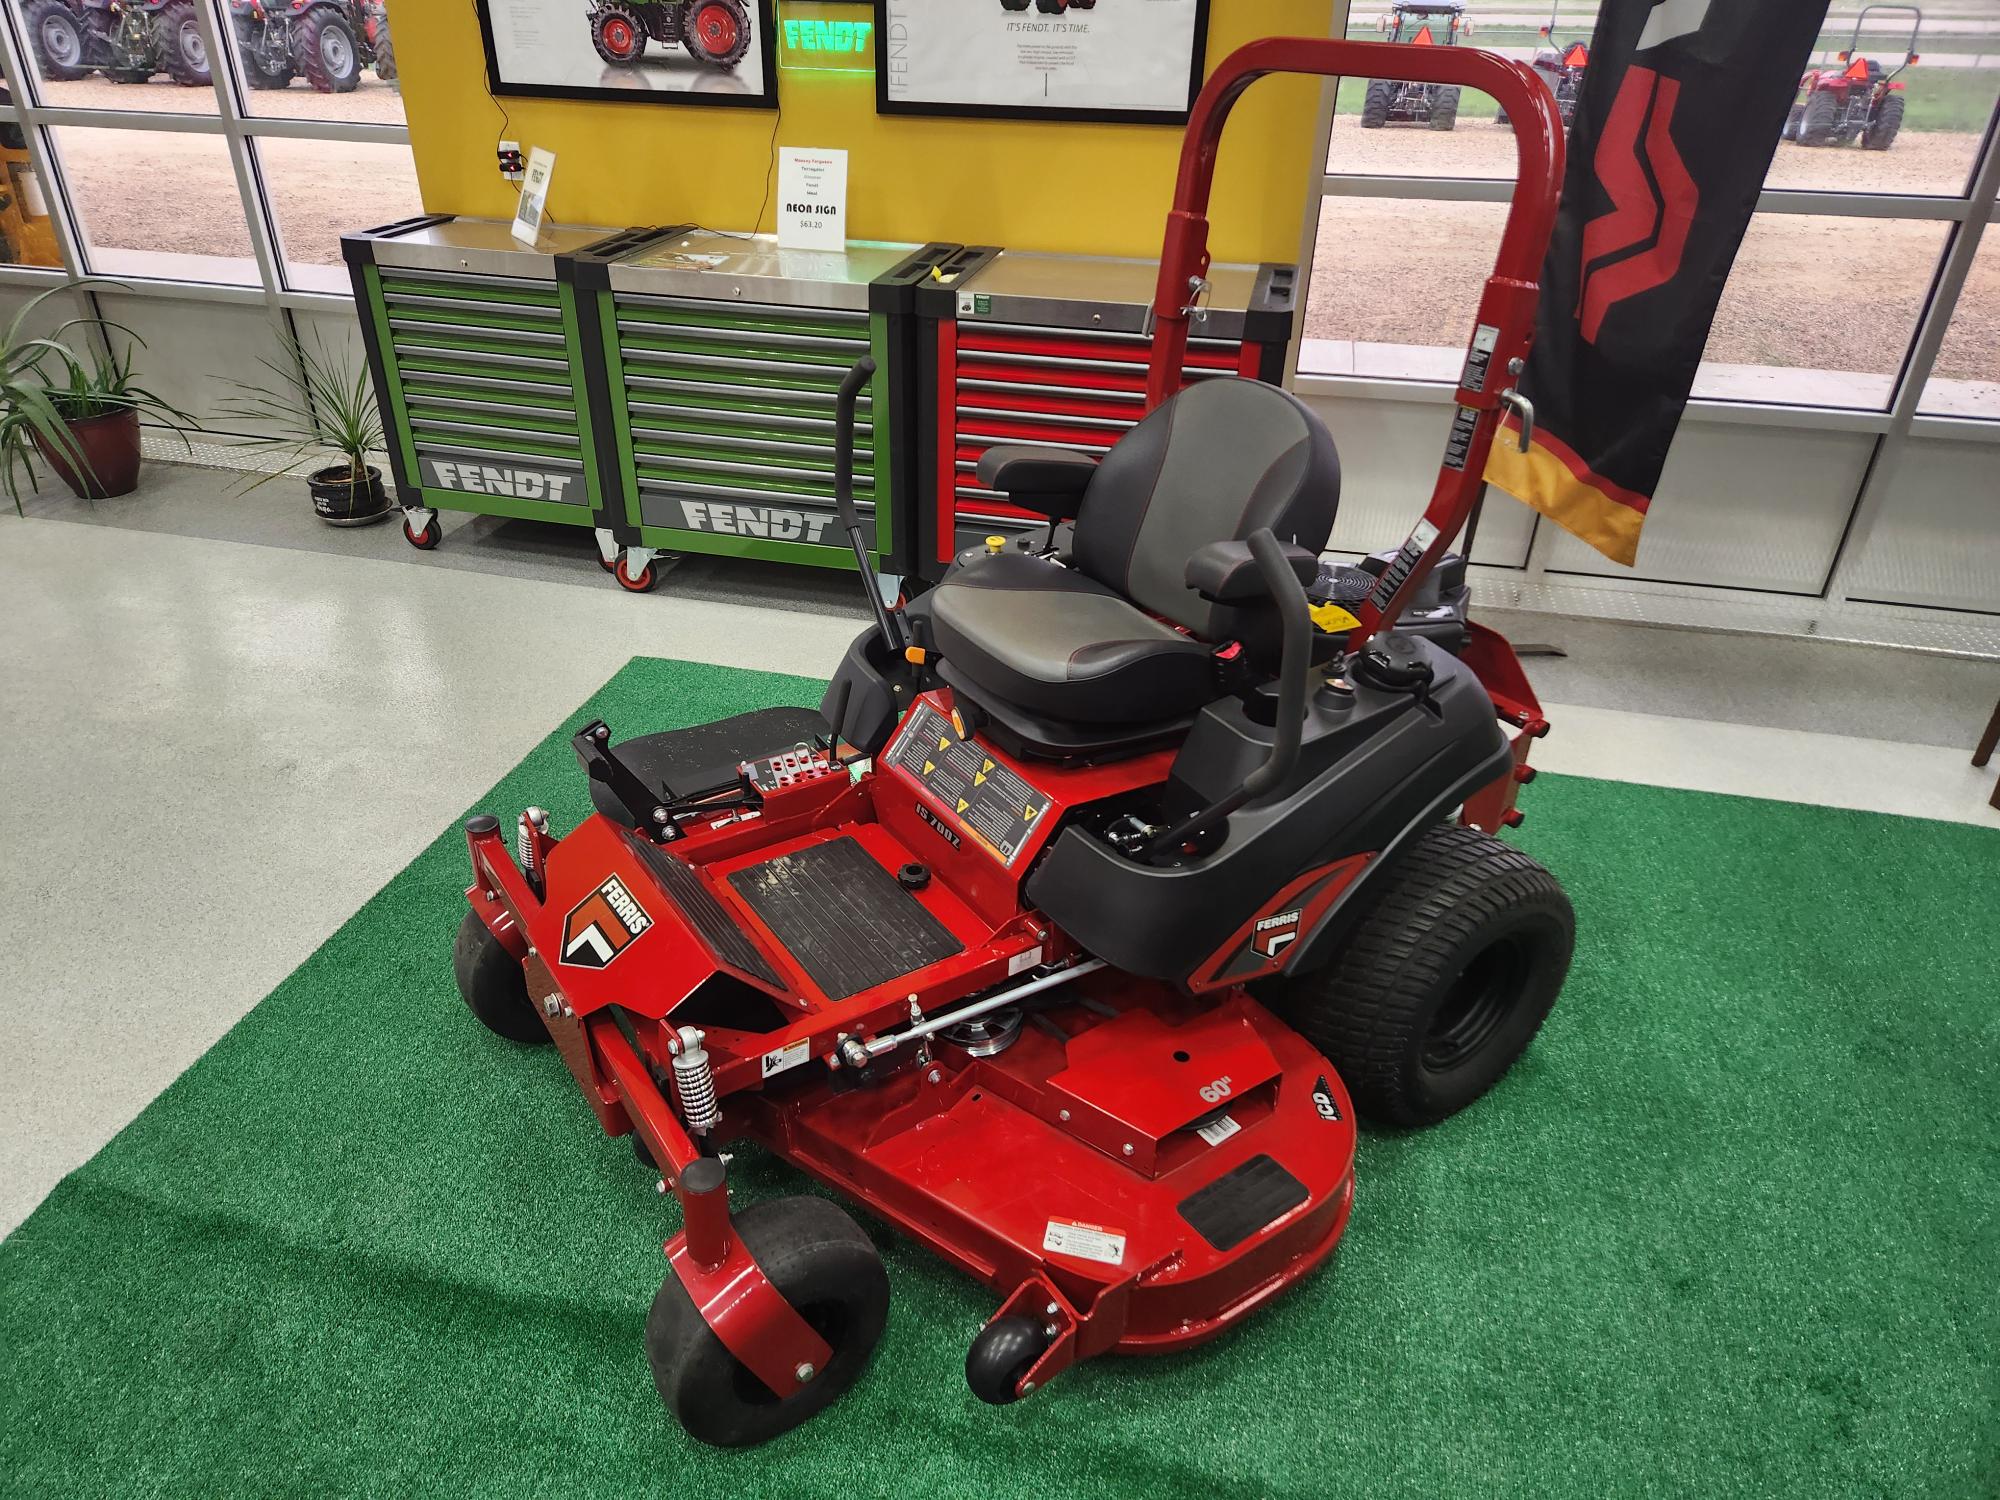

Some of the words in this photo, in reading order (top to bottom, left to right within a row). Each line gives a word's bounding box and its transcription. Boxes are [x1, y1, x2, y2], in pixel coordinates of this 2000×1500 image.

[783, 20, 872, 52] FENDT
[1006, 22, 1021, 32] IT'S
[1022, 22, 1050, 33] FENDT.
[1052, 23, 1067, 33] IT'S
[1069, 23, 1090, 34] TIME.
[786, 203, 812, 213] NEON
[815, 204, 836, 215] SIGN
[800, 220, 823, 229] $63.20
[431, 461, 571, 501] FENDT
[679, 500, 833, 543] FENDT
[916, 803, 929, 820] IS
[930, 815, 960, 849] 700Z
[600, 879, 648, 934] FERRIS
[1256, 911, 1299, 931] FERRIS
[1199, 1075, 1232, 1103] 60"
[1312, 1092, 1338, 1121] iCD
